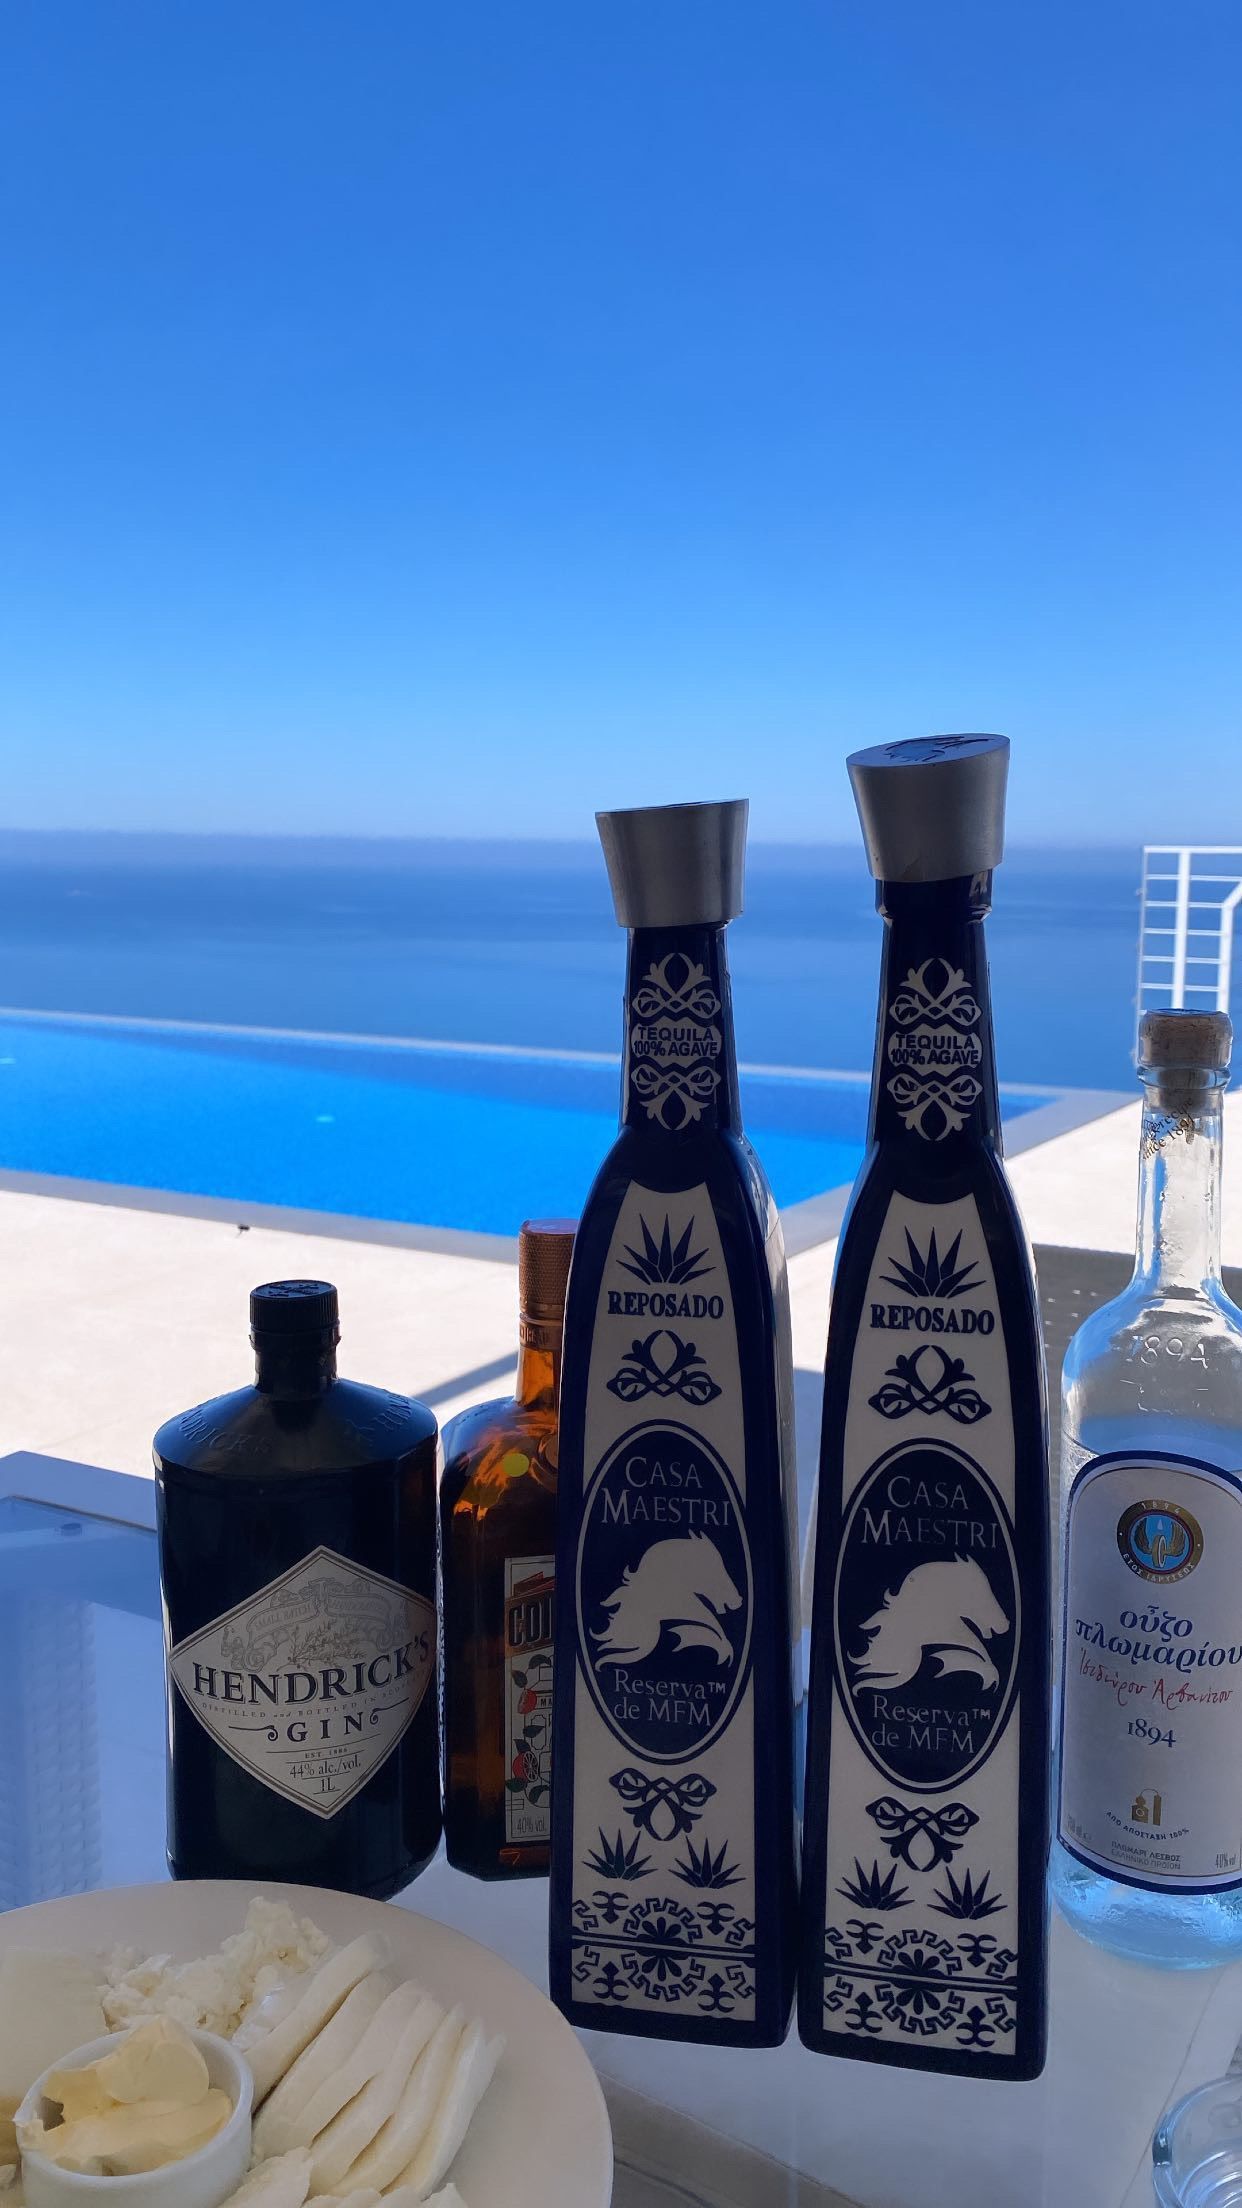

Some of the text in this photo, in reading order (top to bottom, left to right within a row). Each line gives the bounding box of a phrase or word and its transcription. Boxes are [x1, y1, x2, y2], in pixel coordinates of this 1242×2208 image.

[633, 1040, 718, 1058] 100% AGAVE
[638, 1025, 714, 1043] TEQUILA
[896, 1033, 975, 1050] TEQUILA
[891, 1048, 979, 1066] 100% AGAVE
[607, 1290, 724, 1320] REPOSADO
[869, 1303, 995, 1336] REPOSADO
[625, 1456, 703, 1489] CASA
[601, 1487, 732, 1526] MAESTRI
[887, 1475, 969, 1511] CASA
[861, 1506, 998, 1549] MAESTRI
[191, 1630, 430, 1706] HENDRICK'S
[286, 1711, 365, 1743] GIN
[613, 1696, 712, 1727] de MFM
[871, 1723, 975, 1755] de MFM
[1127, 1718, 1177, 1749] 1894
[289, 1763, 315, 1779] 44%
[320, 1777, 337, 1792] 1L
